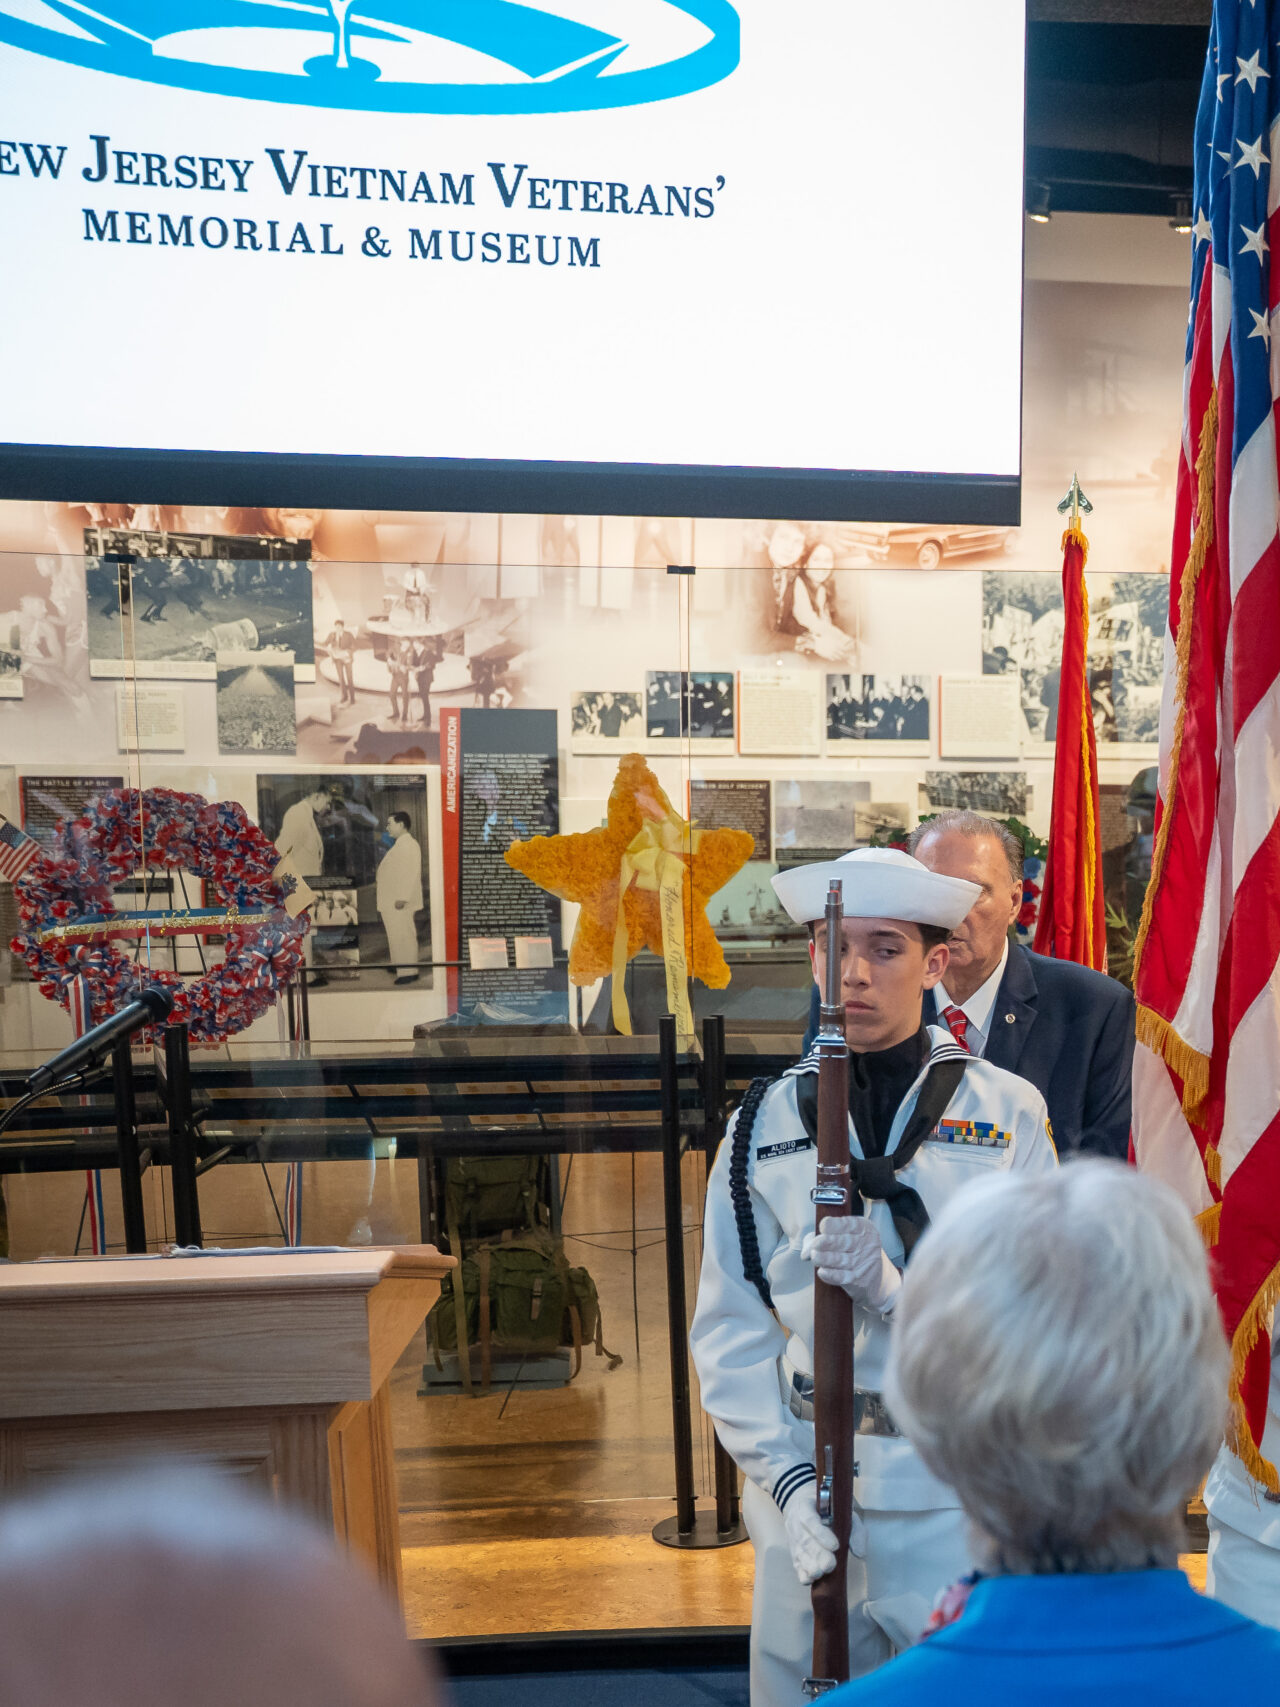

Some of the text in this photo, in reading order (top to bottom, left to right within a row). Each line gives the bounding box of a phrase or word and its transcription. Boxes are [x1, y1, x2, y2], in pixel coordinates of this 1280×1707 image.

[82, 134, 255, 193] JERSEY
[265, 147, 476, 206] VIETNAM
[82, 208, 601, 268] MEMORIAL & MUSEUM
[446, 715, 457, 814] AMERICANIZATION
[771, 1140, 797, 1152] ALIOTO
